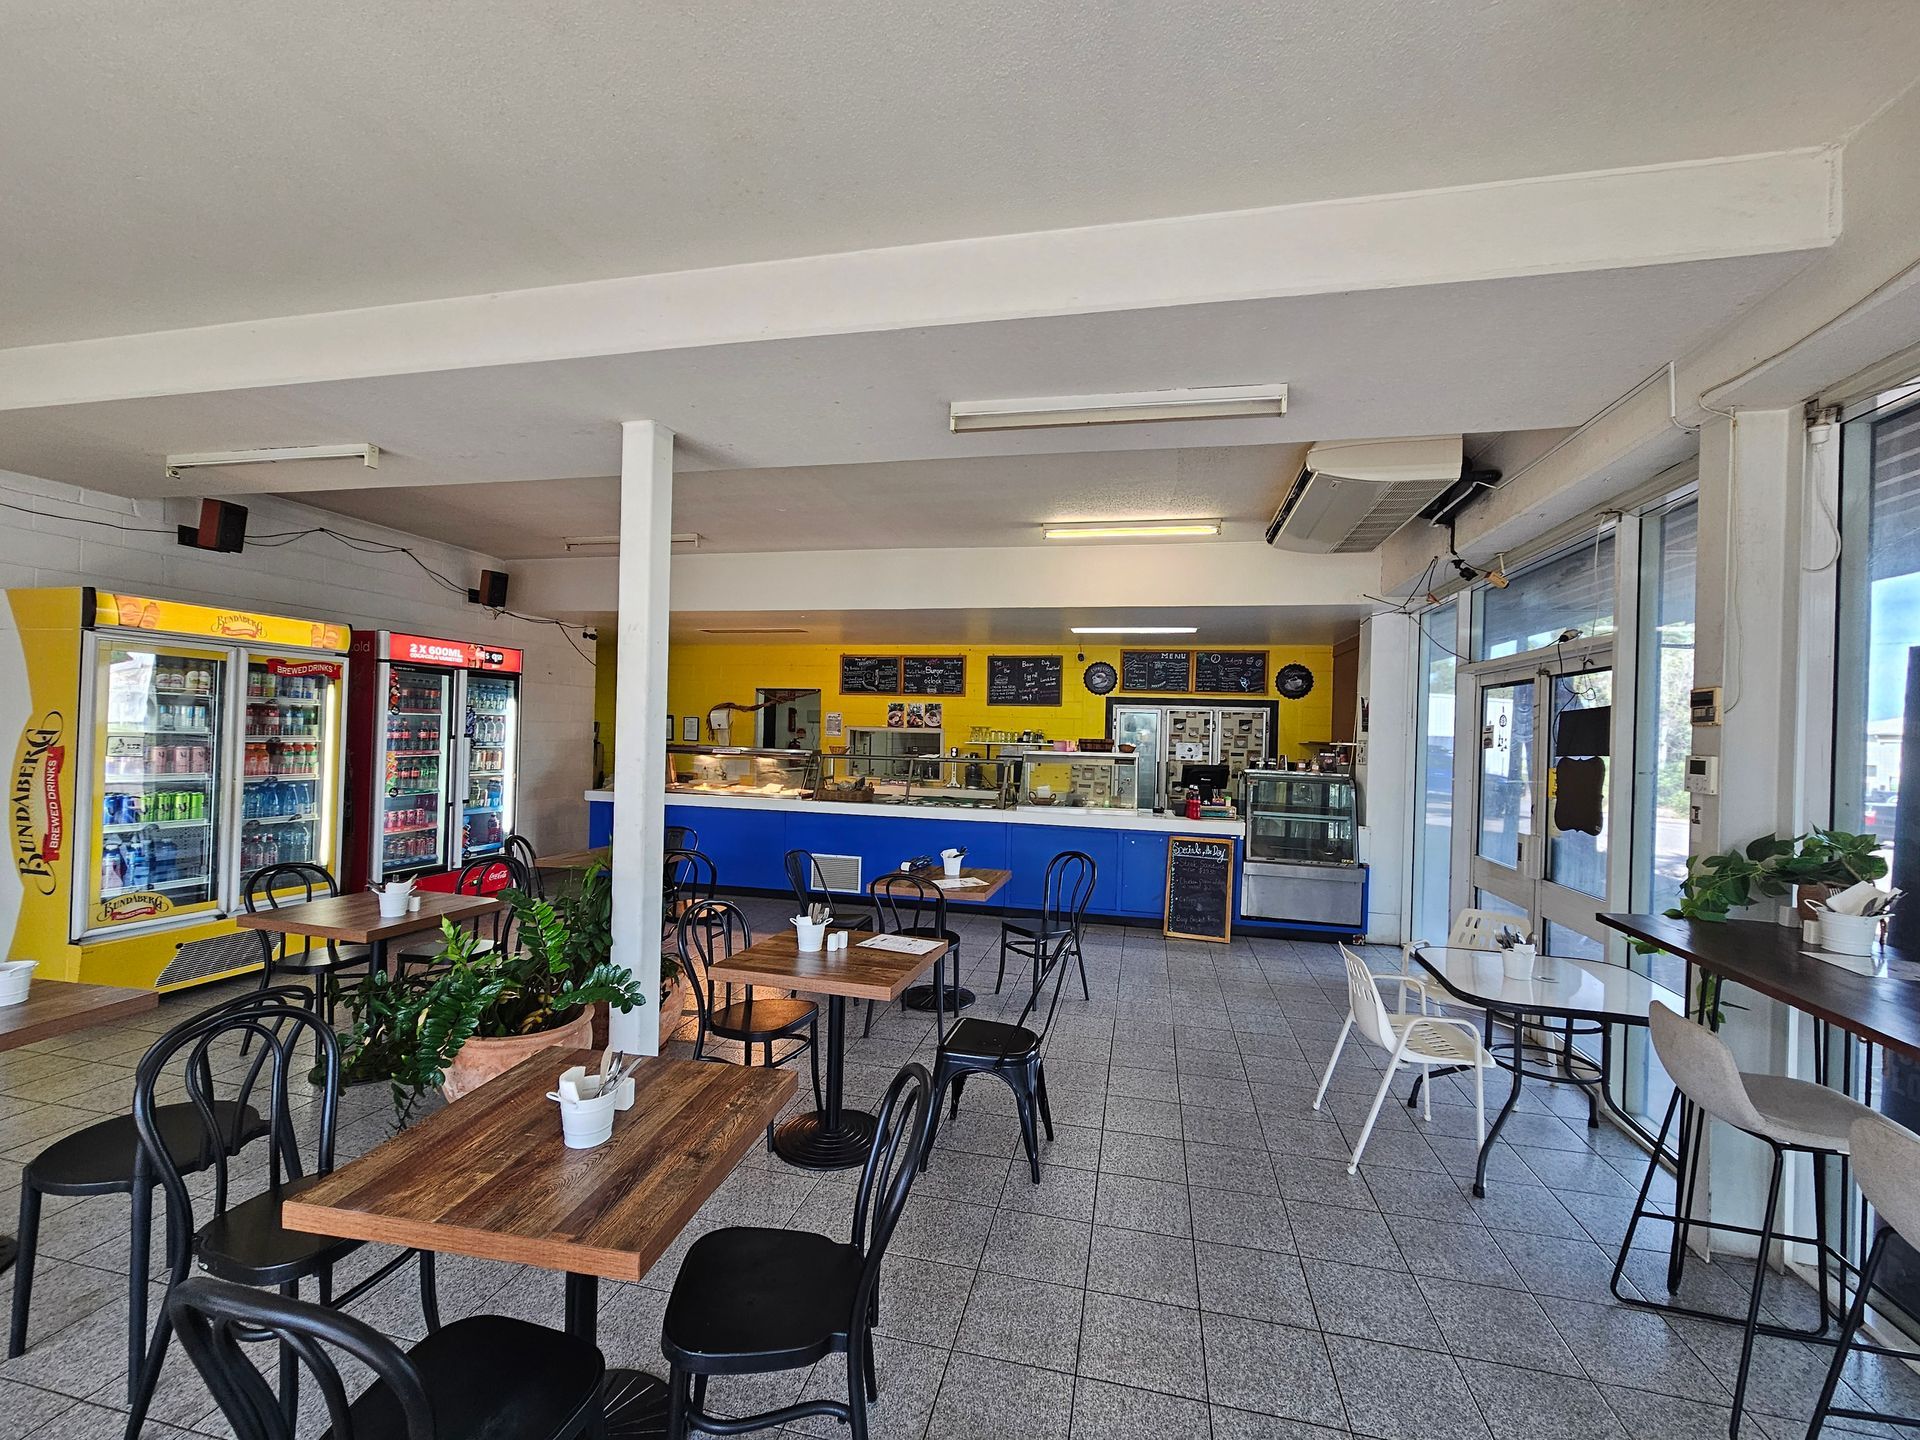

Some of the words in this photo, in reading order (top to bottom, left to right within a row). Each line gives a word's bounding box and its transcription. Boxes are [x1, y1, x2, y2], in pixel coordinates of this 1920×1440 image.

[410, 643, 418, 653] 2
[419, 644, 427, 654] X
[428, 646, 463, 658] 600ML
[1161, 652, 1187, 660] MENU
[277, 665, 307, 675] BREWED
[308, 663, 333, 673] DRINKS
[925, 665, 944, 678] Burger
[46, 760, 57, 799] DRINKS
[11, 711, 63, 895] BUNDABERG
[49, 801, 60, 849] BREWED
[1212, 844, 1226, 863] Day
[97, 895, 169, 922] BUNDABERG
